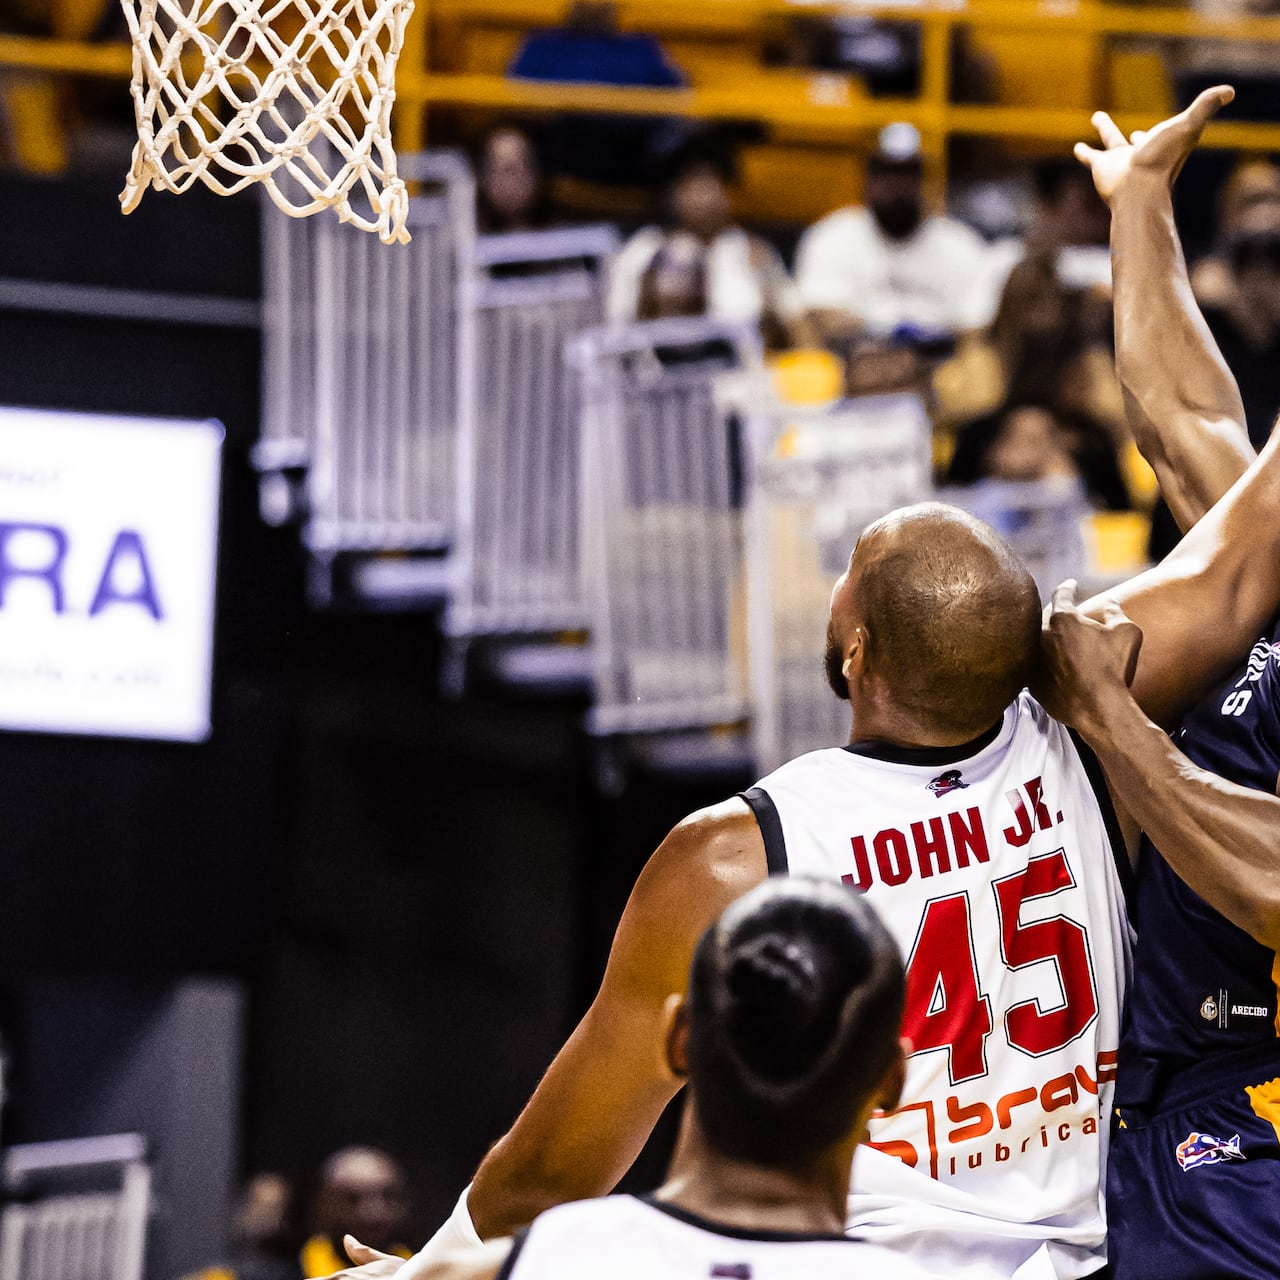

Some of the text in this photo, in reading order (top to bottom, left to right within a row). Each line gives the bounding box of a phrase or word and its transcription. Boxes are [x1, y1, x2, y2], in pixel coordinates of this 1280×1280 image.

[840, 775, 1064, 894] JOHN JR.
[900, 847, 1100, 1086] 45
[1231, 1004, 1268, 1017] ARECIBO
[950, 1117, 1102, 1176] lubrica
